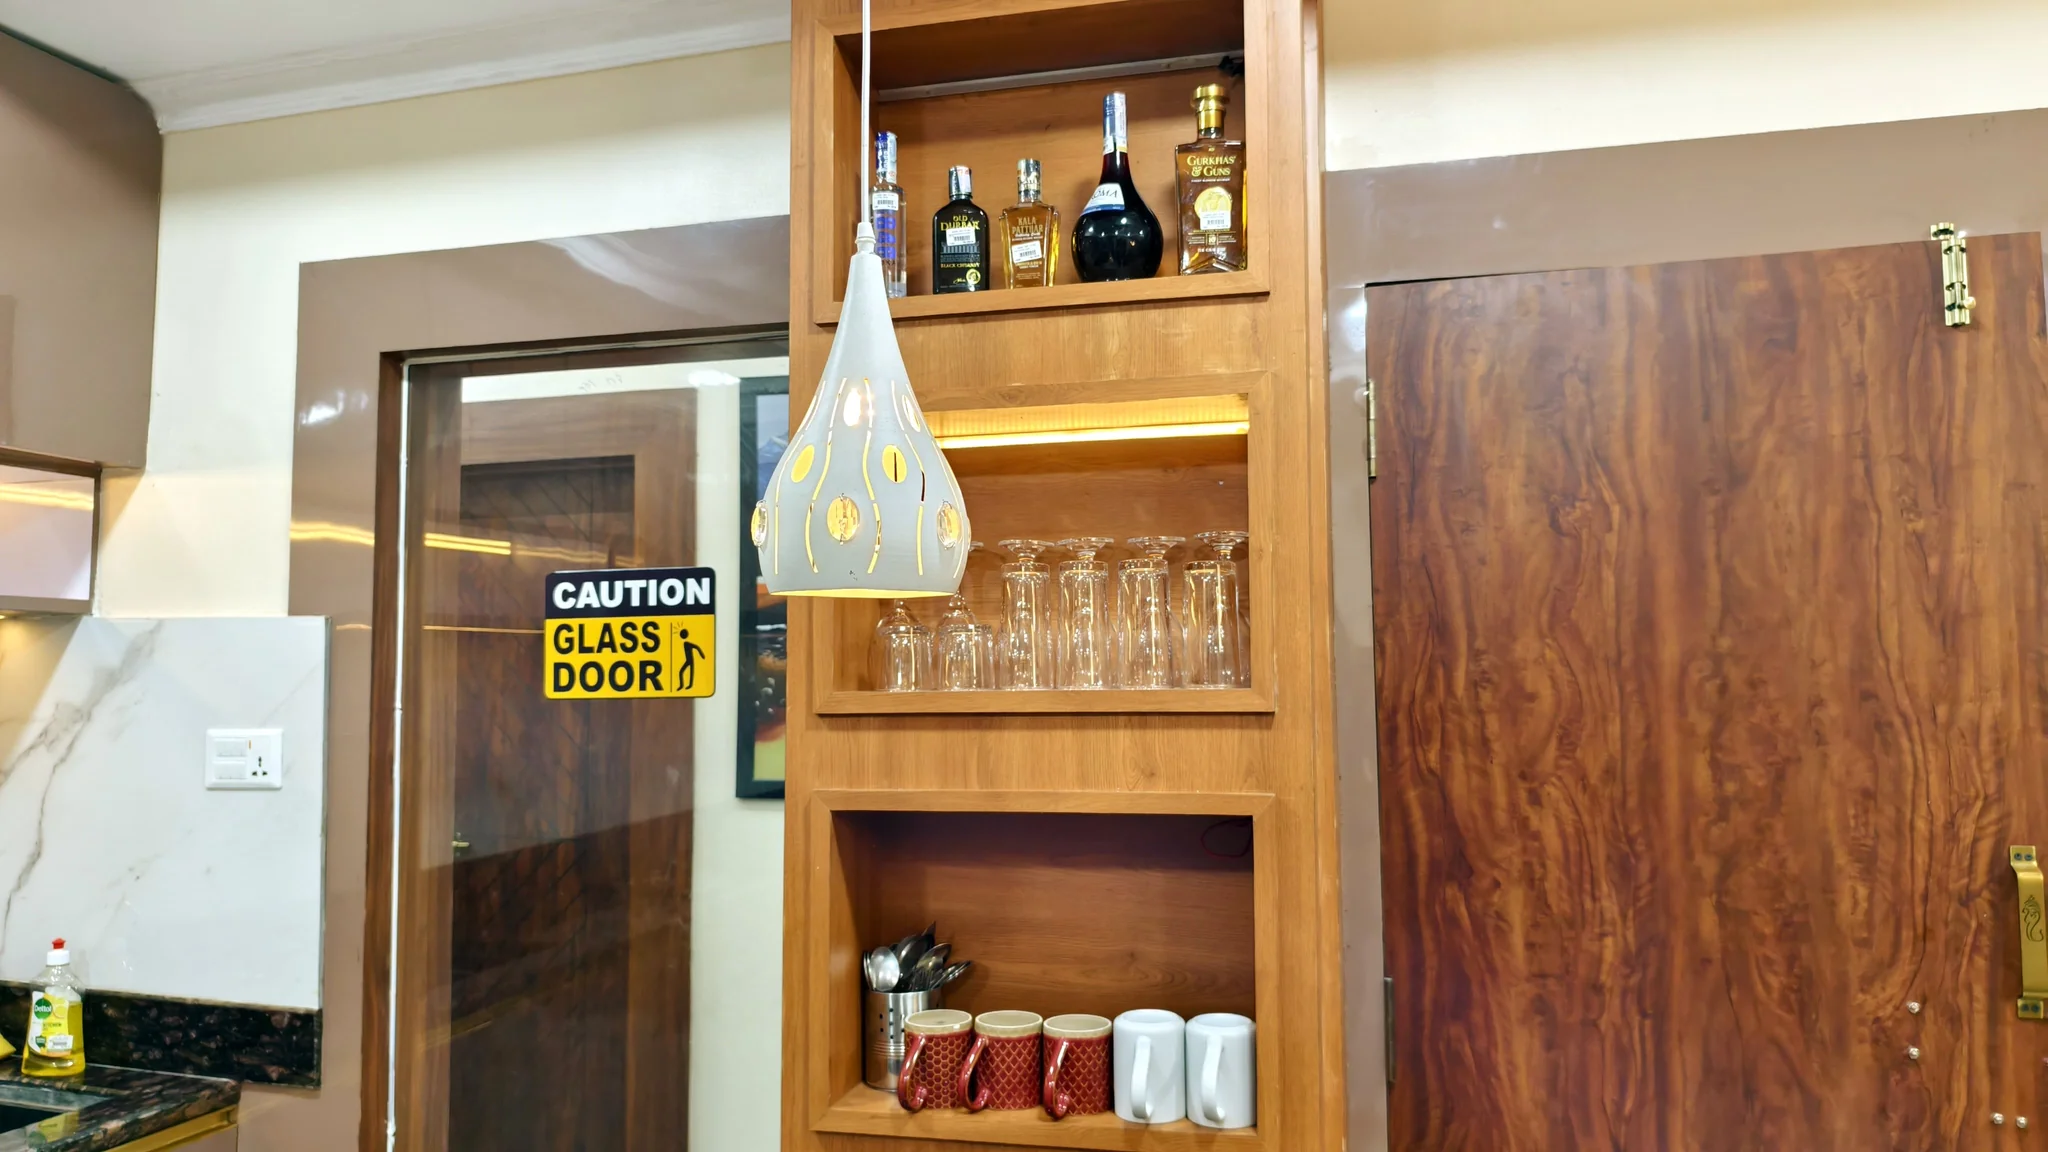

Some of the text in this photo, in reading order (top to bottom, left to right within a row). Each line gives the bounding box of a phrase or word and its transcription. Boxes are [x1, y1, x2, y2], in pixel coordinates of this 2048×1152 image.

[1191, 166, 1231, 177] & GUNS
[553, 577, 711, 610] CAUTION
[553, 621, 661, 655] GLASS
[553, 660, 664, 692] DOOR
[34, 1005, 52, 1013] Dettol
